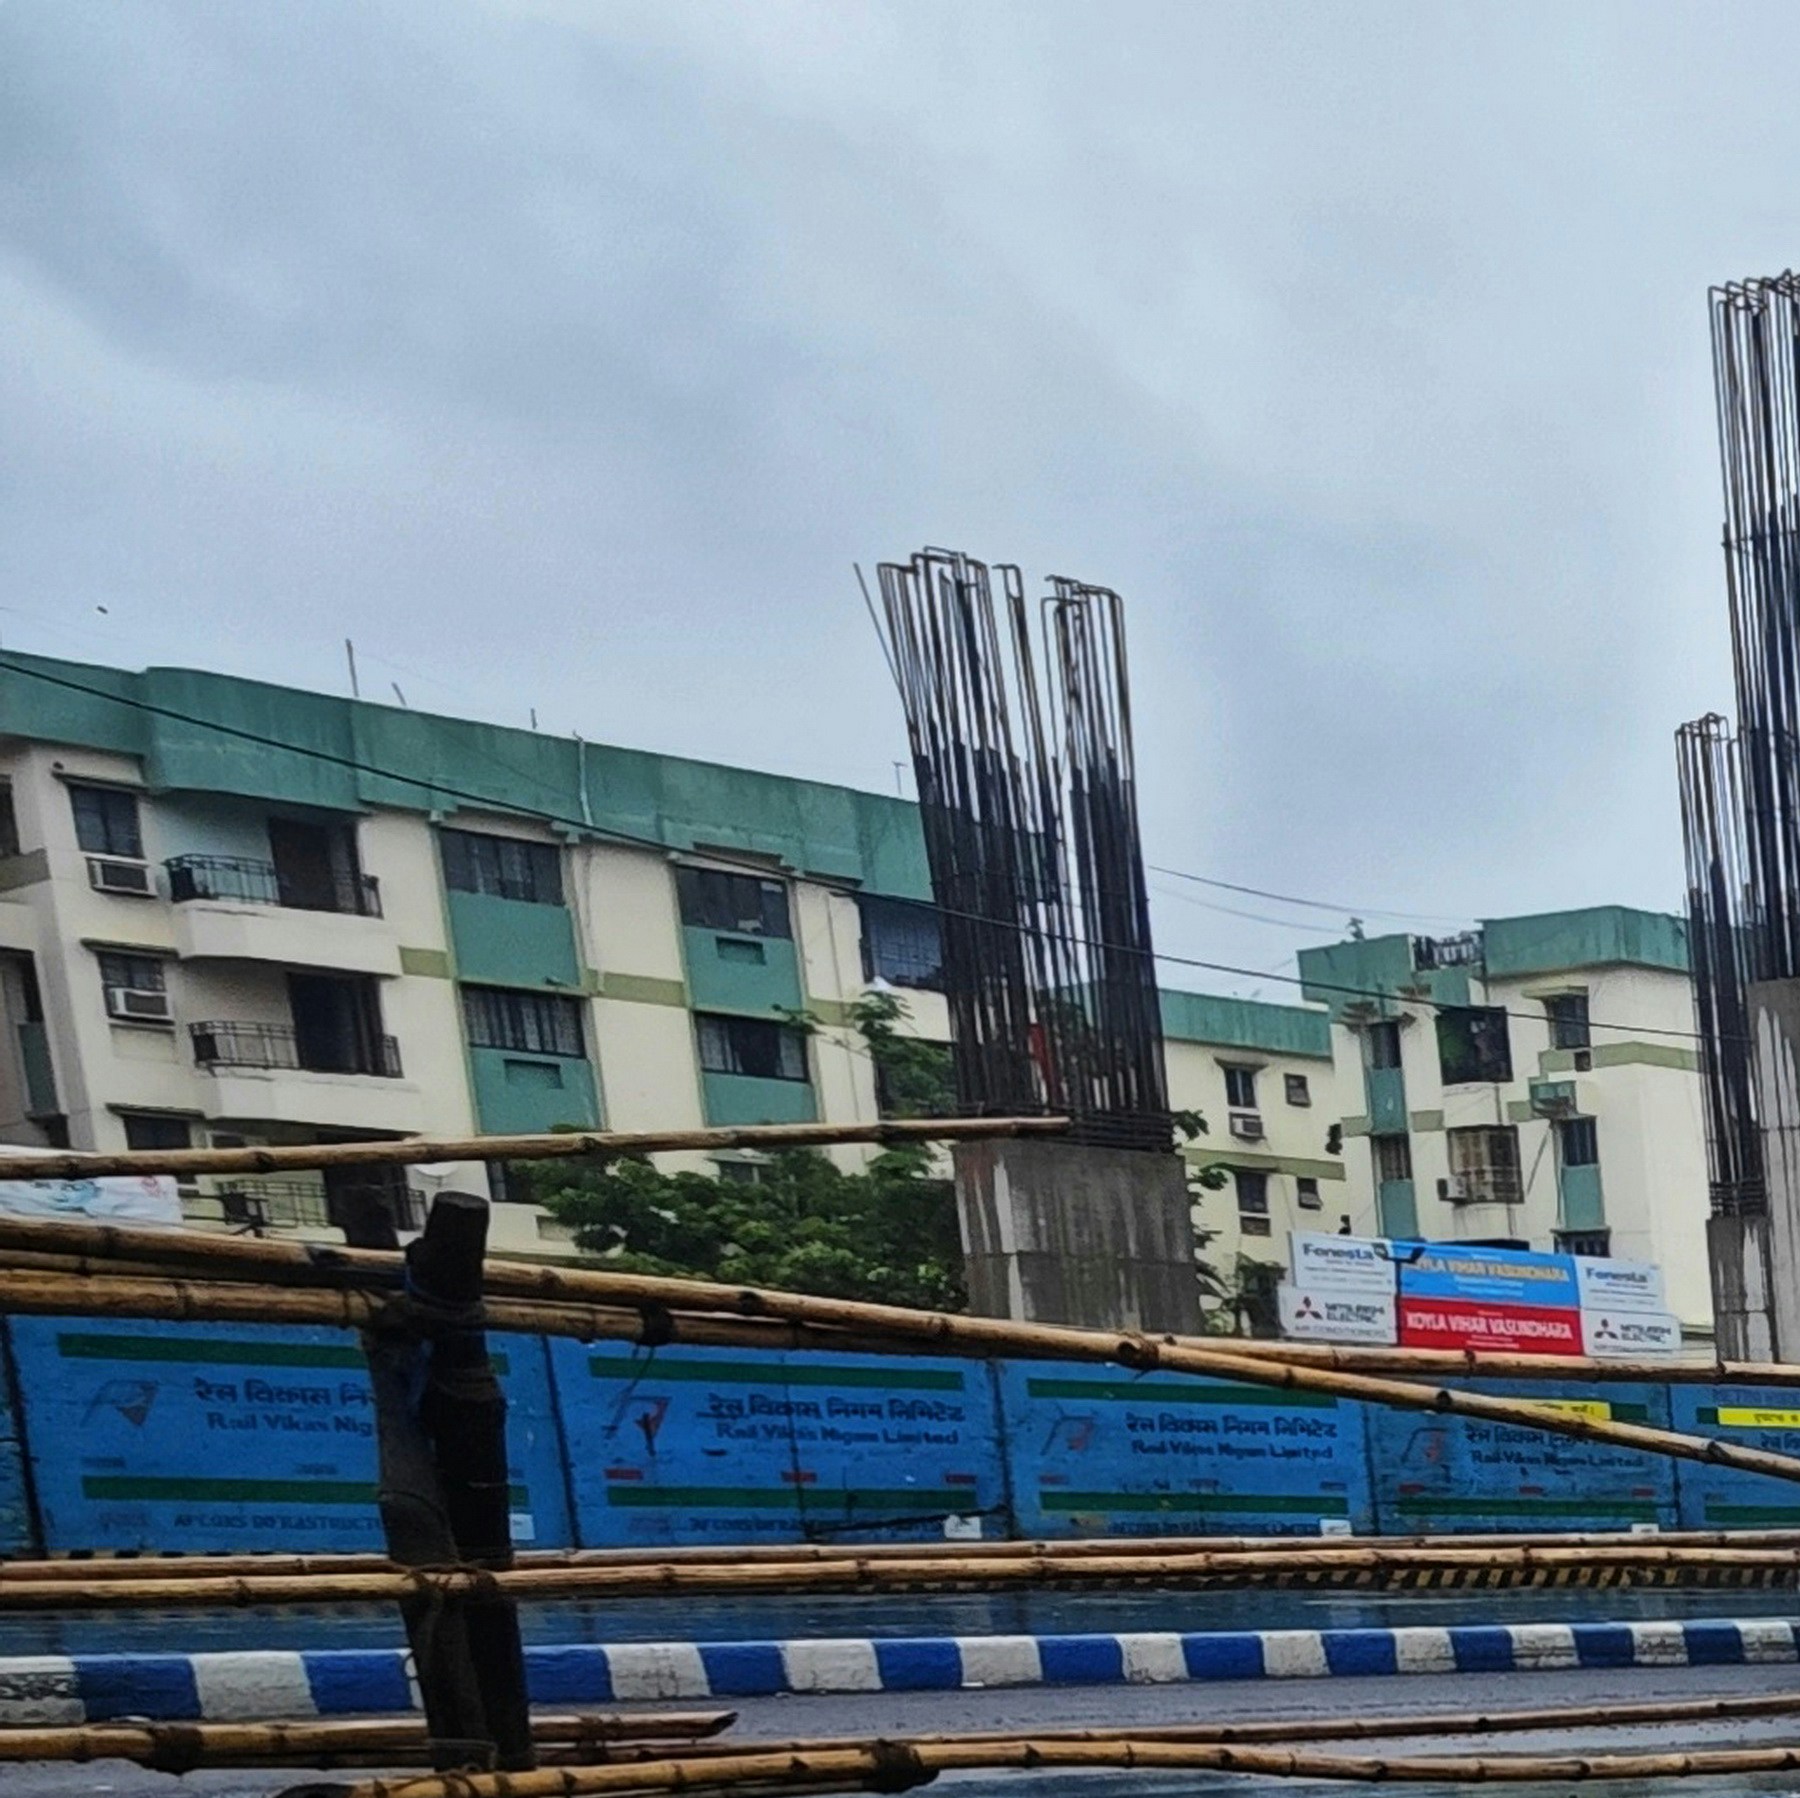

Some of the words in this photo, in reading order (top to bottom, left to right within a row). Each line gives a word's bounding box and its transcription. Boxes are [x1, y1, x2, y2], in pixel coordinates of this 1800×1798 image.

[1303, 1243, 1375, 1260] Fenesta
[207, 1412, 257, 1431] Rail
[263, 1414, 330, 1432] Vikas
[335, 1415, 373, 1437] Nig
